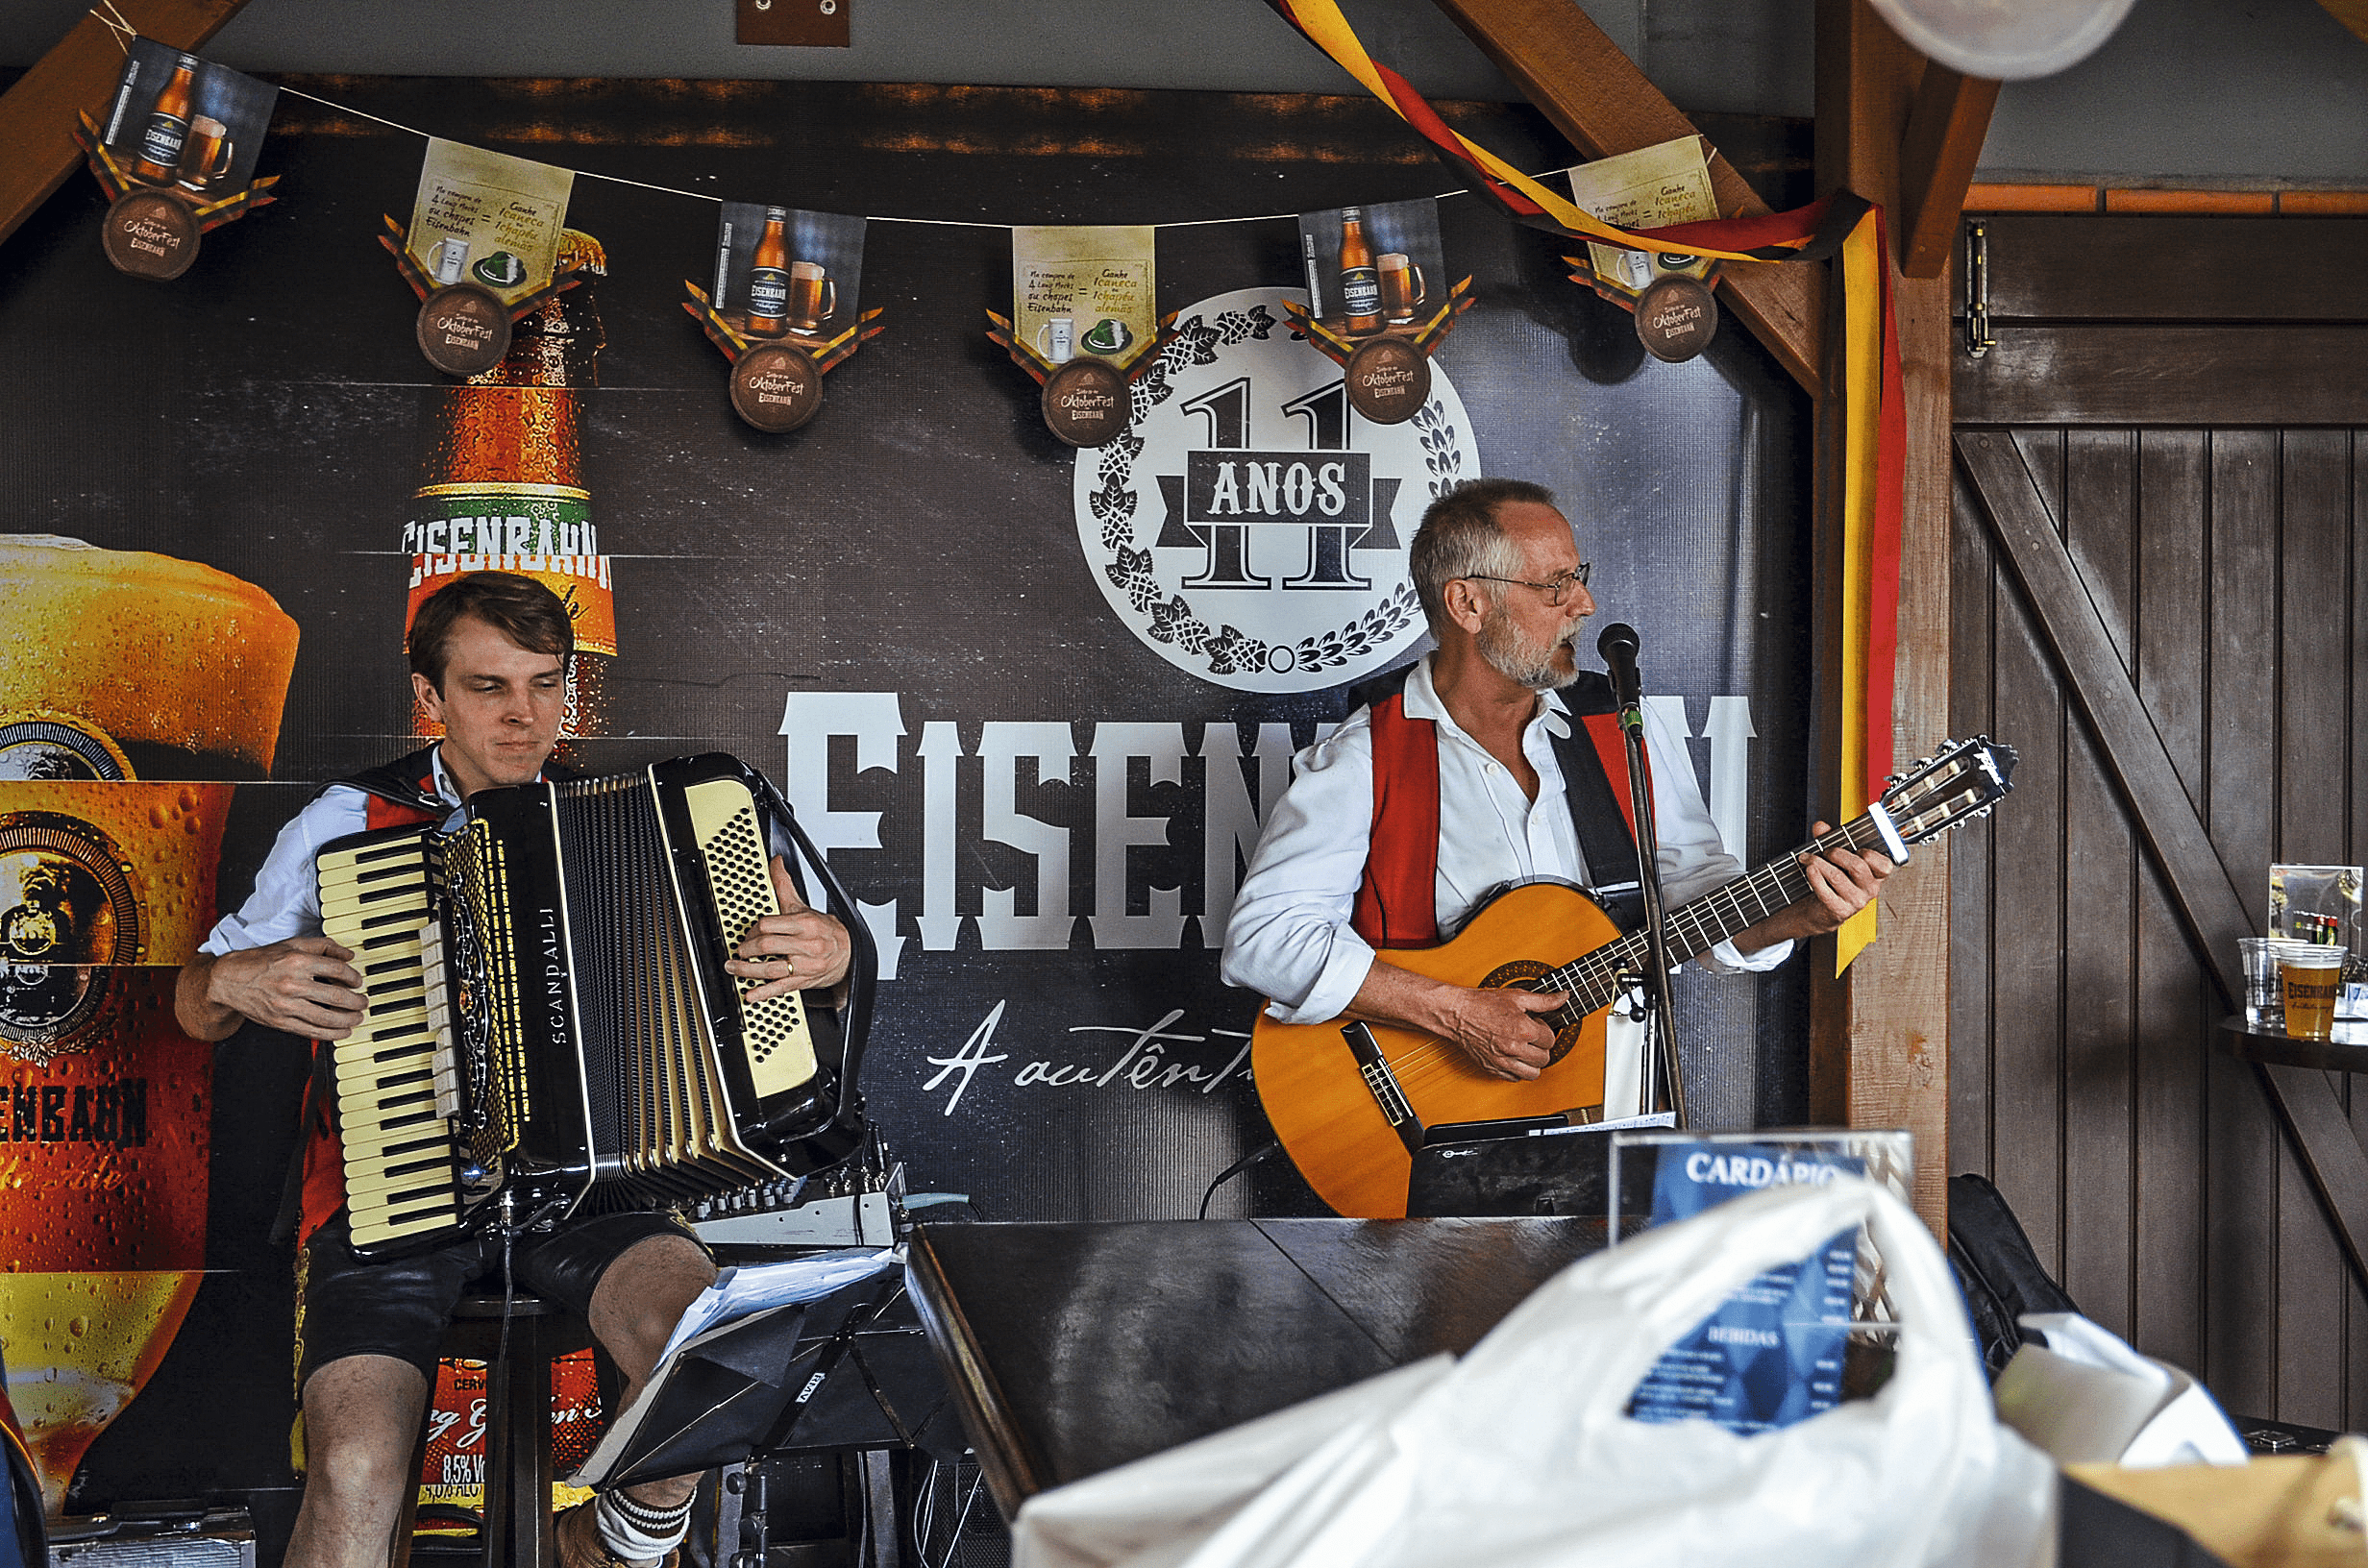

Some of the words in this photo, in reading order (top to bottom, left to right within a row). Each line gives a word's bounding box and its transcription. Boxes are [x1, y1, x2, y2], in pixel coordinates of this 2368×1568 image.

[426, 216, 471, 237] Eisenbahn
[1027, 303, 1073, 313] Eisenbahn
[1180, 377, 1372, 592] 11
[1206, 460, 1346, 517] ANOS
[777, 691, 1758, 981] EISEN
[539, 908, 567, 1044] SCANDALLI
[923, 998, 1008, 1117] A
[1014, 1008, 1253, 1093] autênt
[454, 1379, 485, 1392] CERV
